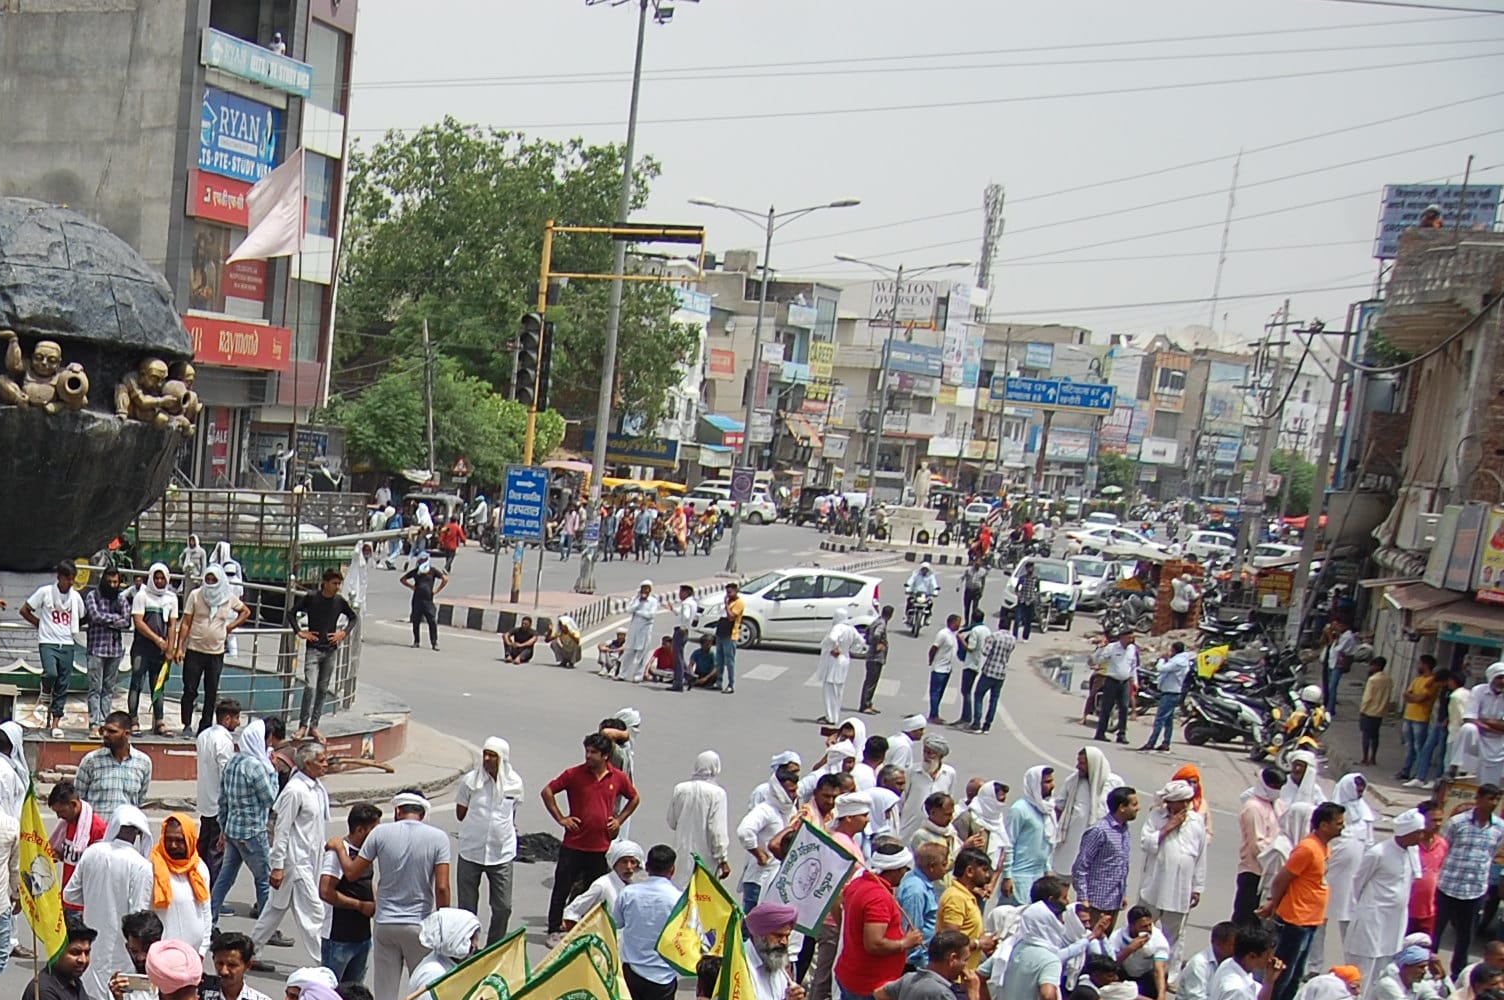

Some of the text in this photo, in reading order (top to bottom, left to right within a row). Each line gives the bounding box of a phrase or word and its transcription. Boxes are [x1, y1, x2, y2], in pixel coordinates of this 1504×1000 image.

[219, 106, 260, 143] RYAN
[874, 294, 932, 306] OVERSEAS
[218, 328, 259, 361] Raymond
